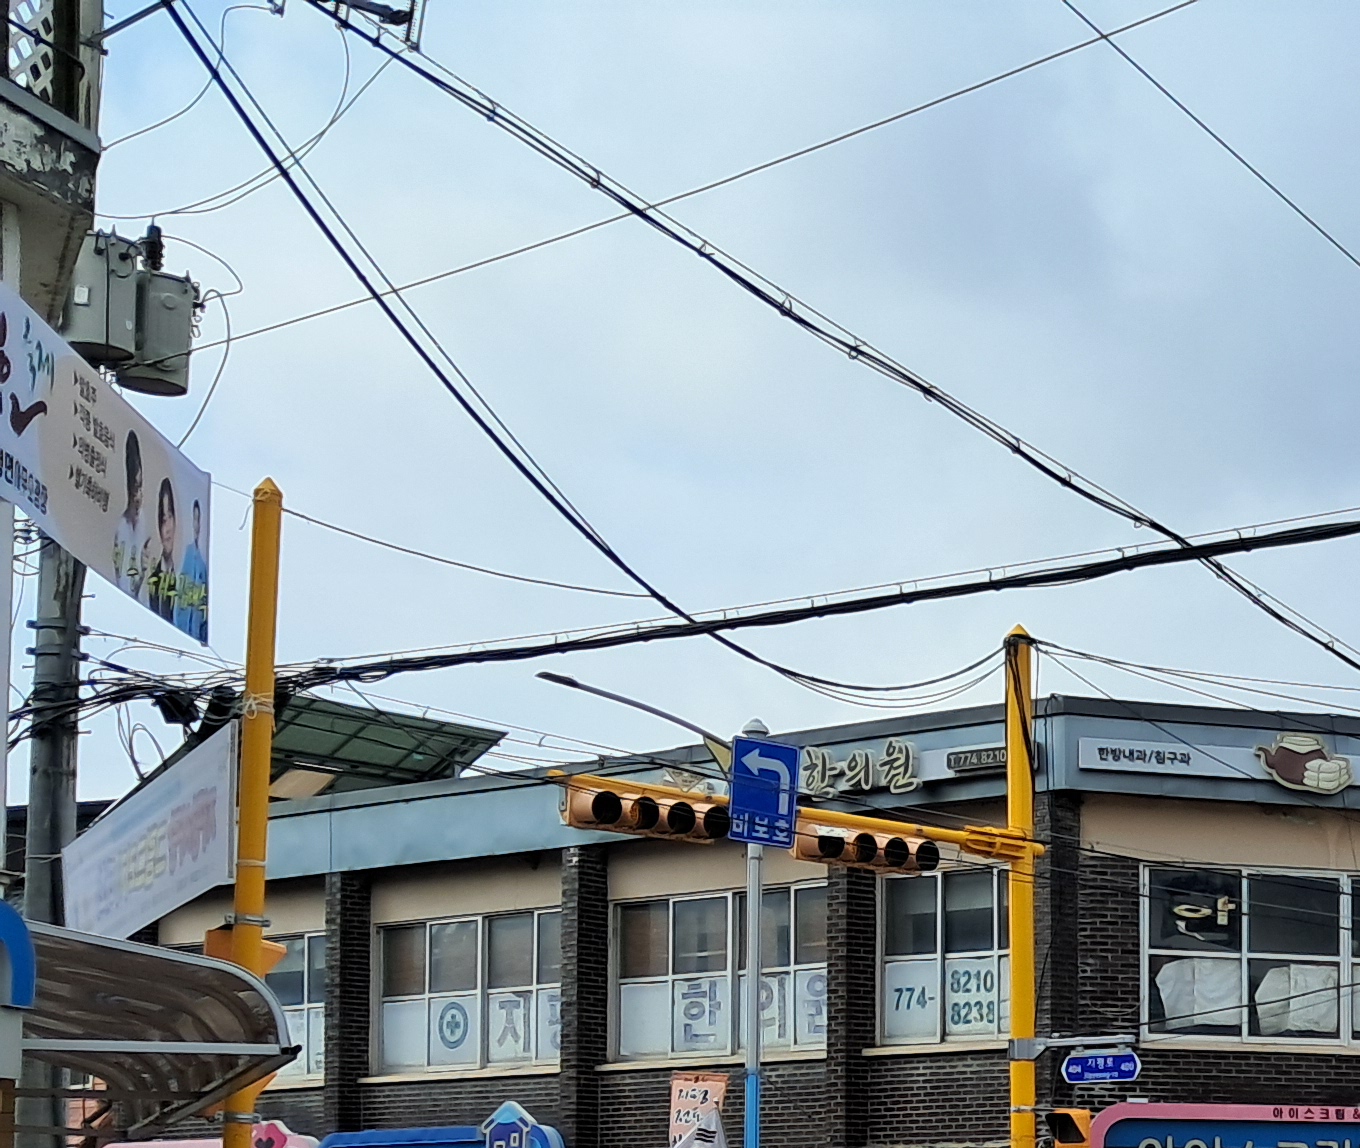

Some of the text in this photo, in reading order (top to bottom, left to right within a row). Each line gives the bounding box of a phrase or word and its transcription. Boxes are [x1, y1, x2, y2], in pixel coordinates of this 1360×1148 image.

[800, 737, 922, 800] 한의원
[1097, 746, 1192, 767] 한방내과/침구과
[732, 812, 791, 843] 비보호
[950, 969, 995, 994] 8210
[950, 1001, 995, 1026] 8238
[1272, 1107, 1345, 1120] 아이스크림
[1352, 1109, 1360, 1119] &
